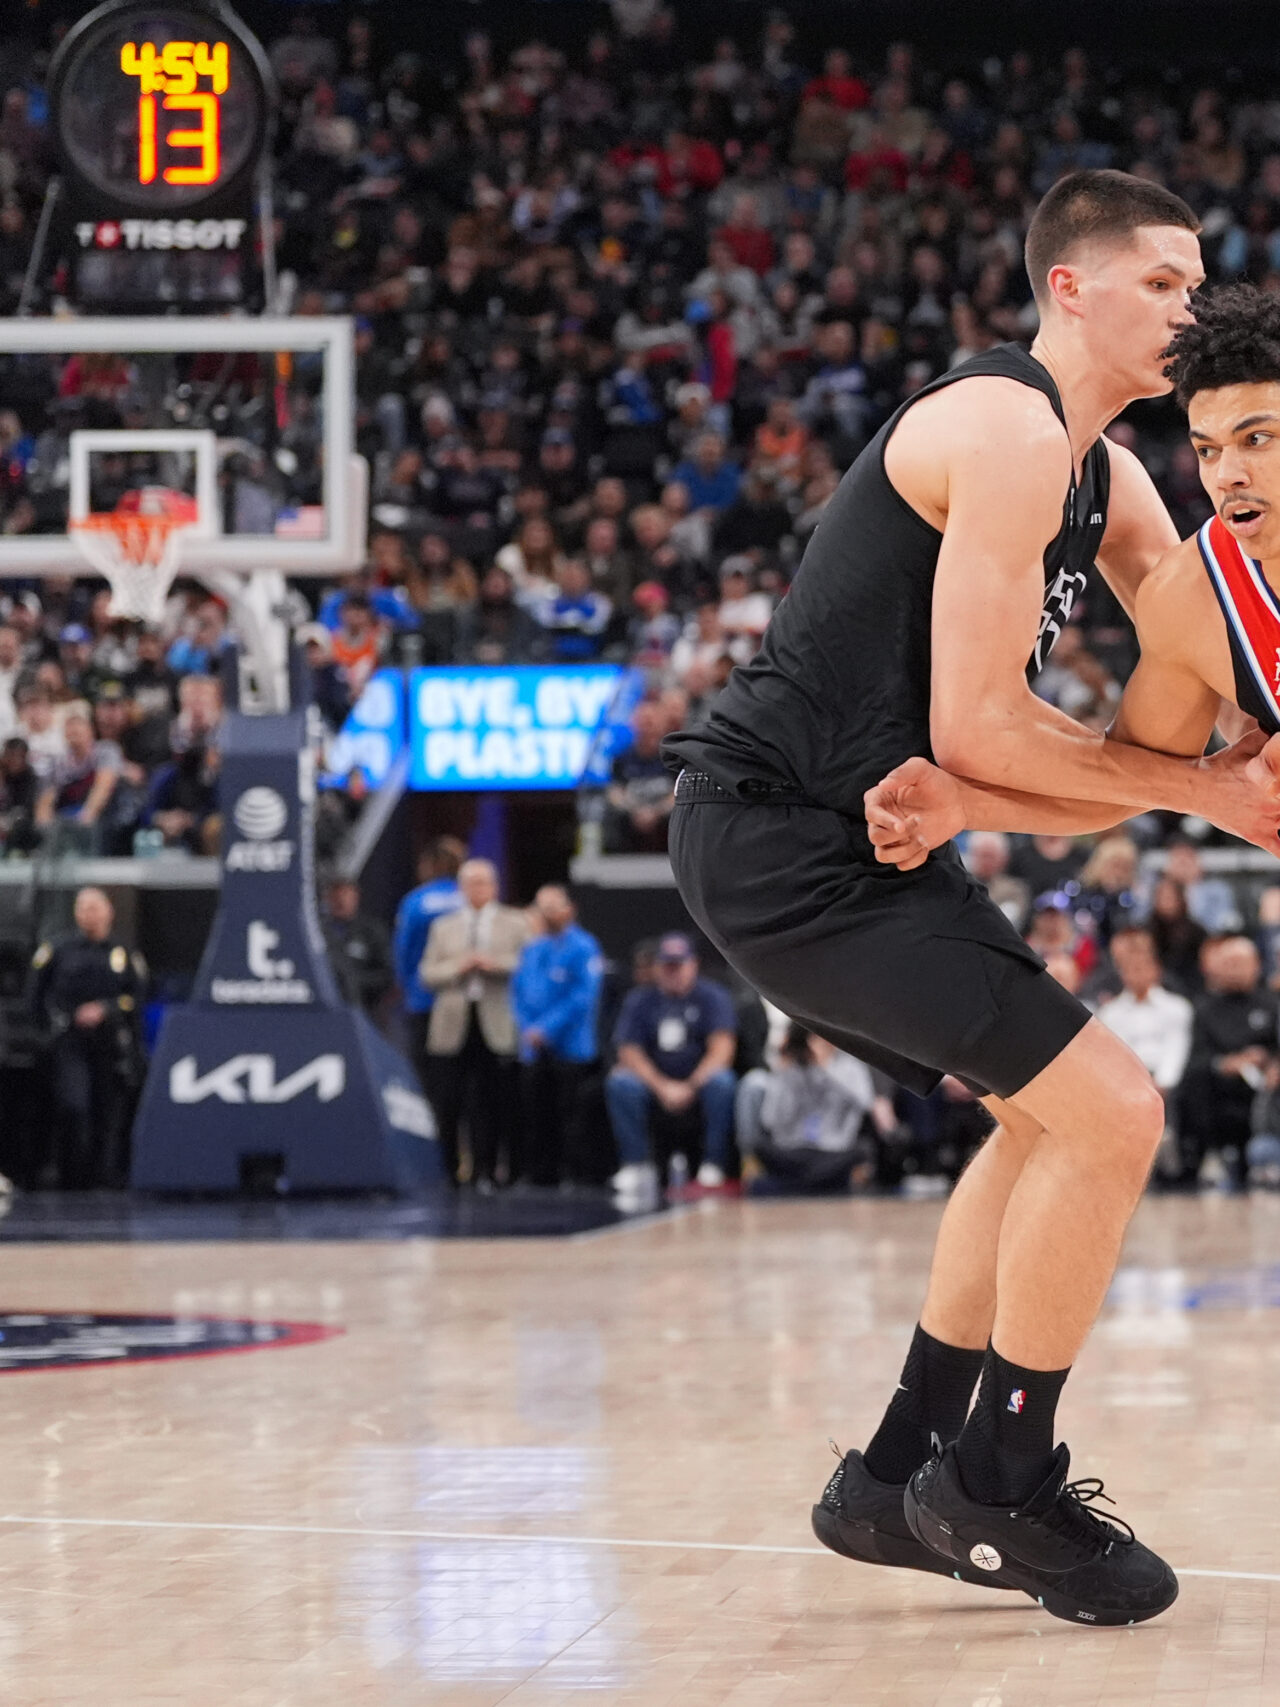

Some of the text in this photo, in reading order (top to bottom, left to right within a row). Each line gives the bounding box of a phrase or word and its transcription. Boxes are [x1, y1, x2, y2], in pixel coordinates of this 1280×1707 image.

[120, 42, 229, 95] 4:54
[138, 92, 220, 185] 13
[120, 219, 246, 250] TISSOT
[418, 676, 533, 728] BYE,
